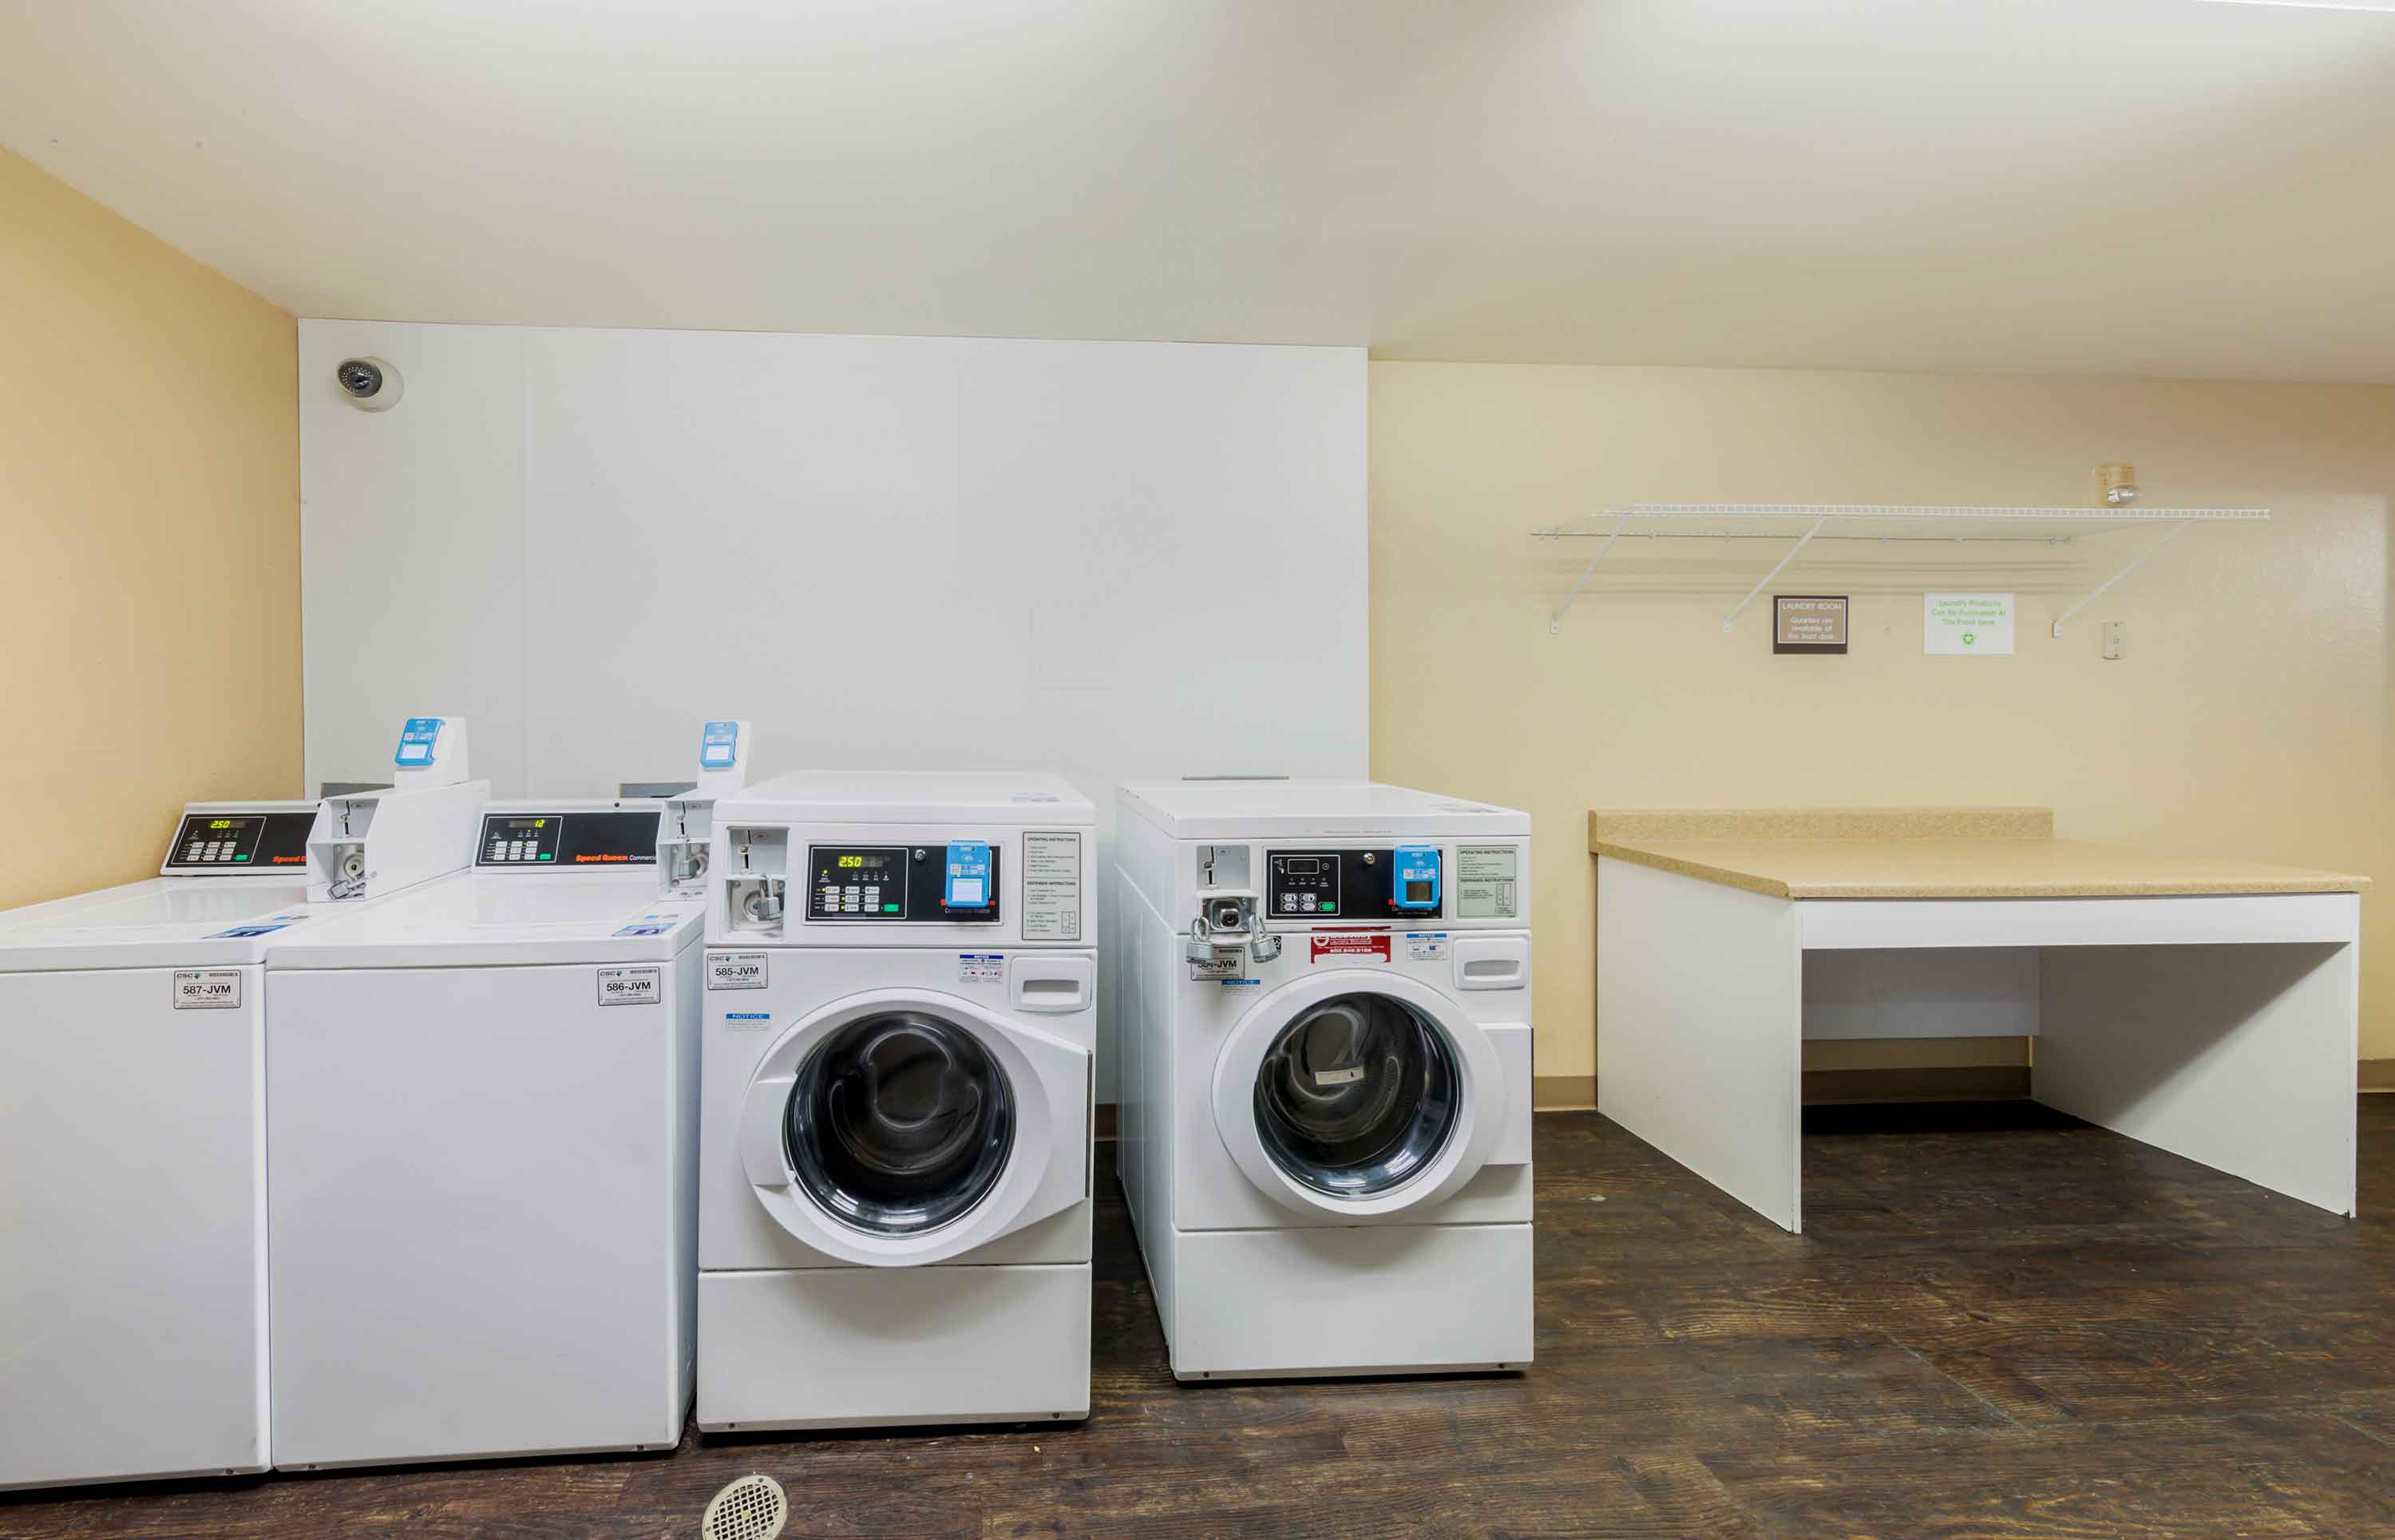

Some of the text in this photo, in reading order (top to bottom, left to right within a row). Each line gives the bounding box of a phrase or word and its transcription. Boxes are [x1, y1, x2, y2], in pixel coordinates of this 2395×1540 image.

[535, 819, 545, 828] 12
[273, 855, 300, 864] Speed
[839, 856, 862, 868] 2.50
[715, 967, 759, 976] 585-JVM
[183, 985, 231, 994] 587-JVM
[607, 981, 651, 992] 586-JVM
